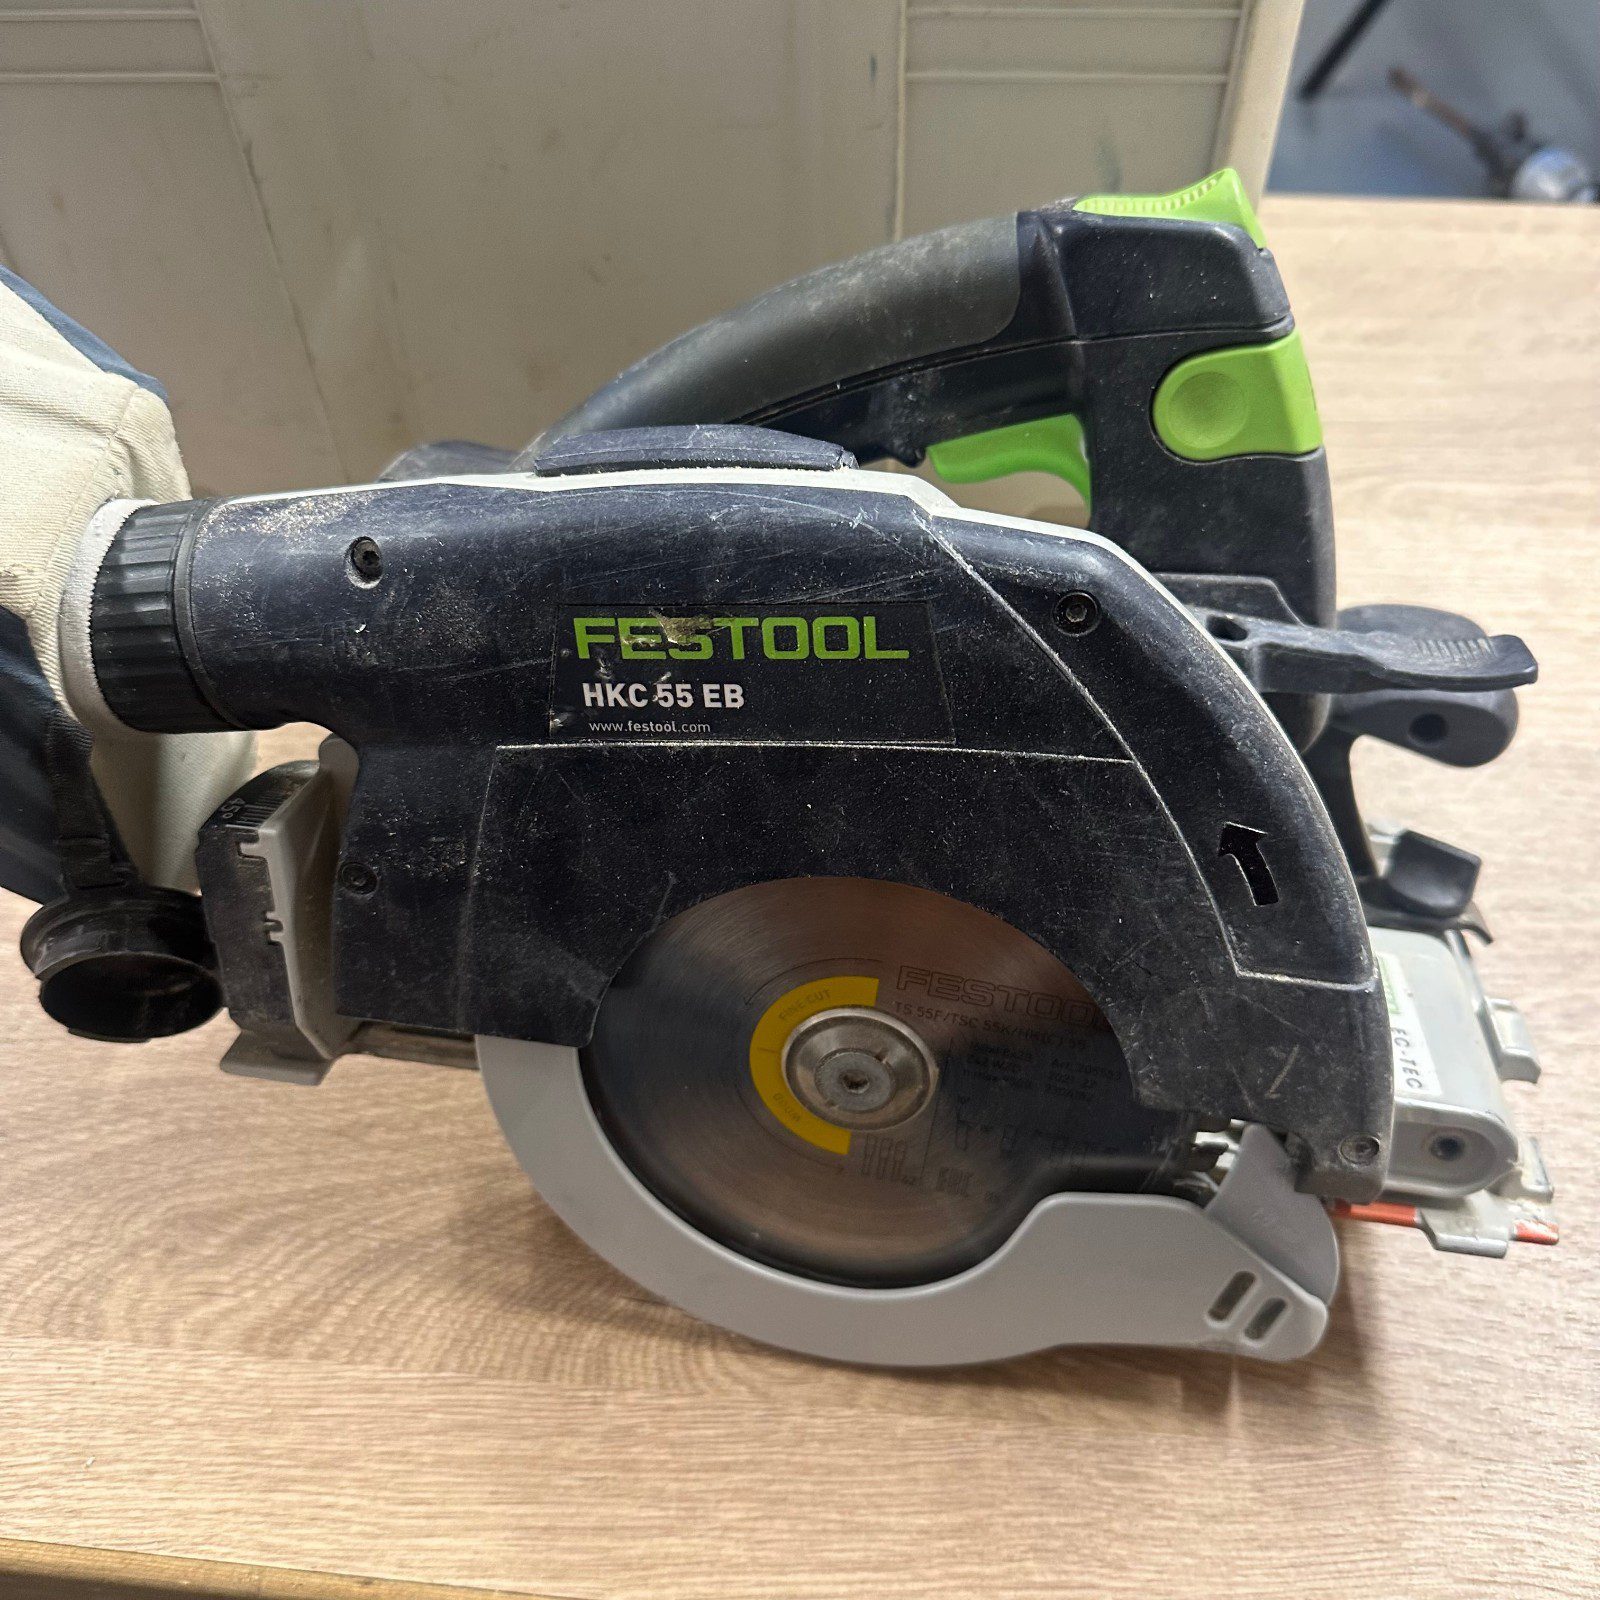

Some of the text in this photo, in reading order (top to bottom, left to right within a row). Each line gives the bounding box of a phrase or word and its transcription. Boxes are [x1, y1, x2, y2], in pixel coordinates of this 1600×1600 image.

[573, 615, 910, 660] FESTOOL
[582, 682, 745, 709] HKC 55 EB
[588, 719, 711, 734] www.festool.com
